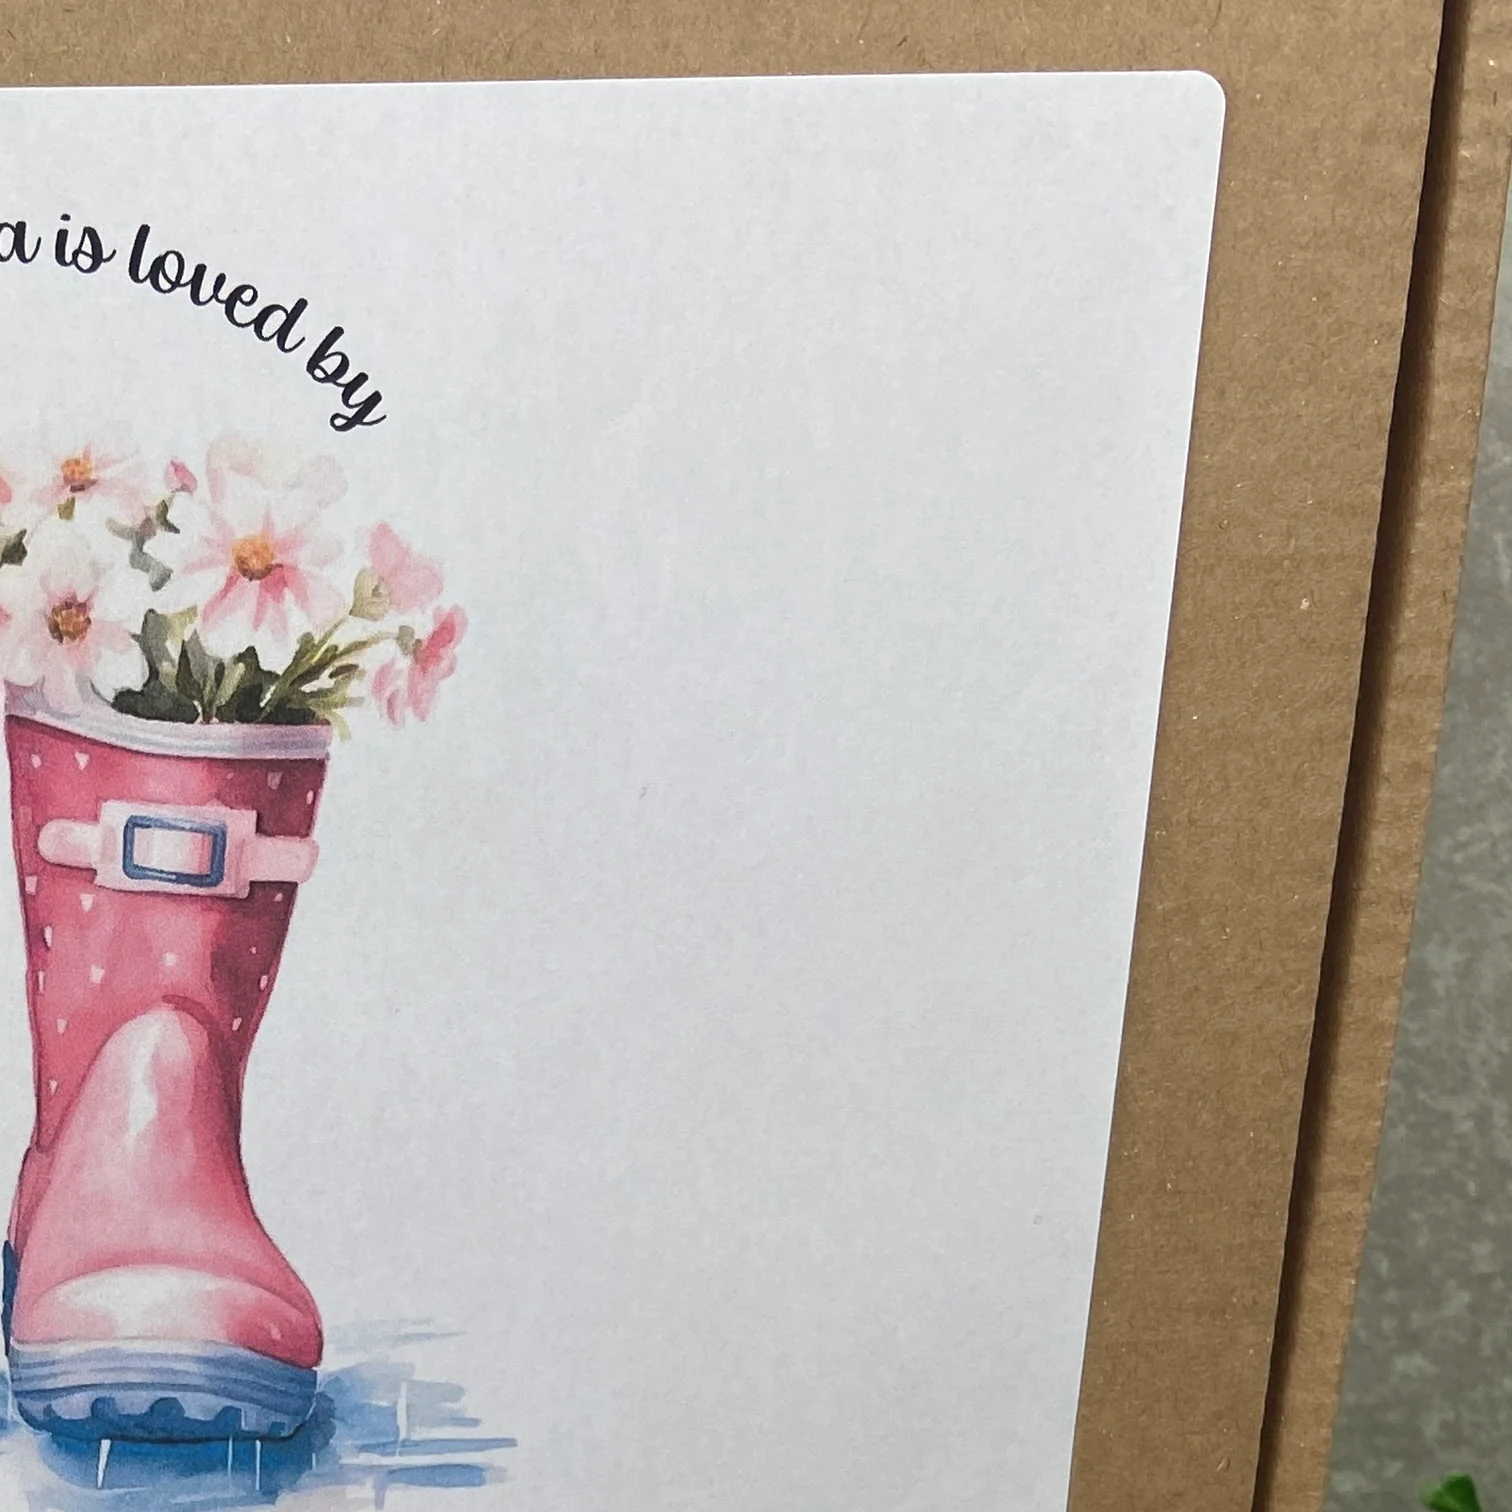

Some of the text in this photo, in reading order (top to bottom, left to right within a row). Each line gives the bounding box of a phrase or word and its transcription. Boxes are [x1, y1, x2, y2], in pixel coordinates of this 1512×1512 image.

[55, 213, 116, 273] is
[128, 224, 308, 353] loved
[306, 326, 387, 432] by
